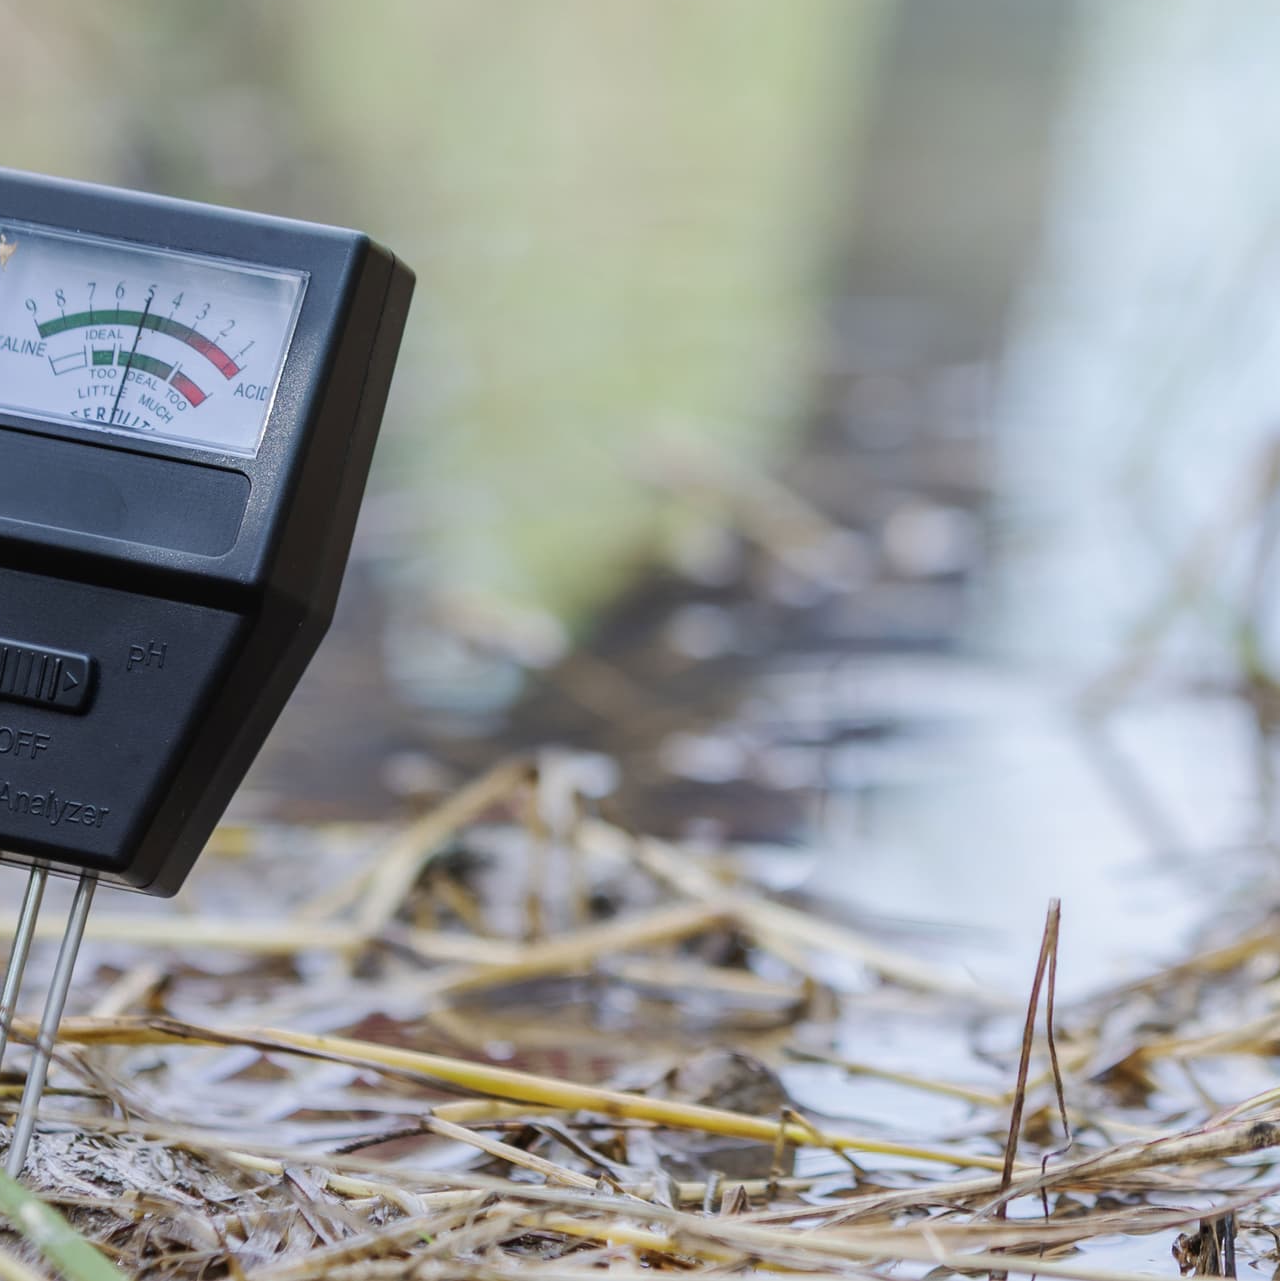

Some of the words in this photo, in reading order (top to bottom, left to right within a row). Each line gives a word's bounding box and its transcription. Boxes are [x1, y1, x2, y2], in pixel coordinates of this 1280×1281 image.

[25, 299, 37, 315] 9
[55, 288, 66, 306] 8
[87, 282, 97, 299] 7
[115, 281, 125, 298] 6
[145, 284, 158, 302] 5
[172, 292, 184, 309] 4
[196, 302, 211, 320] 3
[220, 319, 236, 337] 2
[240, 340, 255, 356] 1
[85, 328, 124, 341] IDEAL
[89, 368, 117, 379] TOO
[125, 371, 158, 391] DEAL
[78, 385, 128, 399] LITTLE
[164, 388, 187, 411] TOO
[138, 393, 174, 424] MUCH
[127, 640, 169, 671] pH
